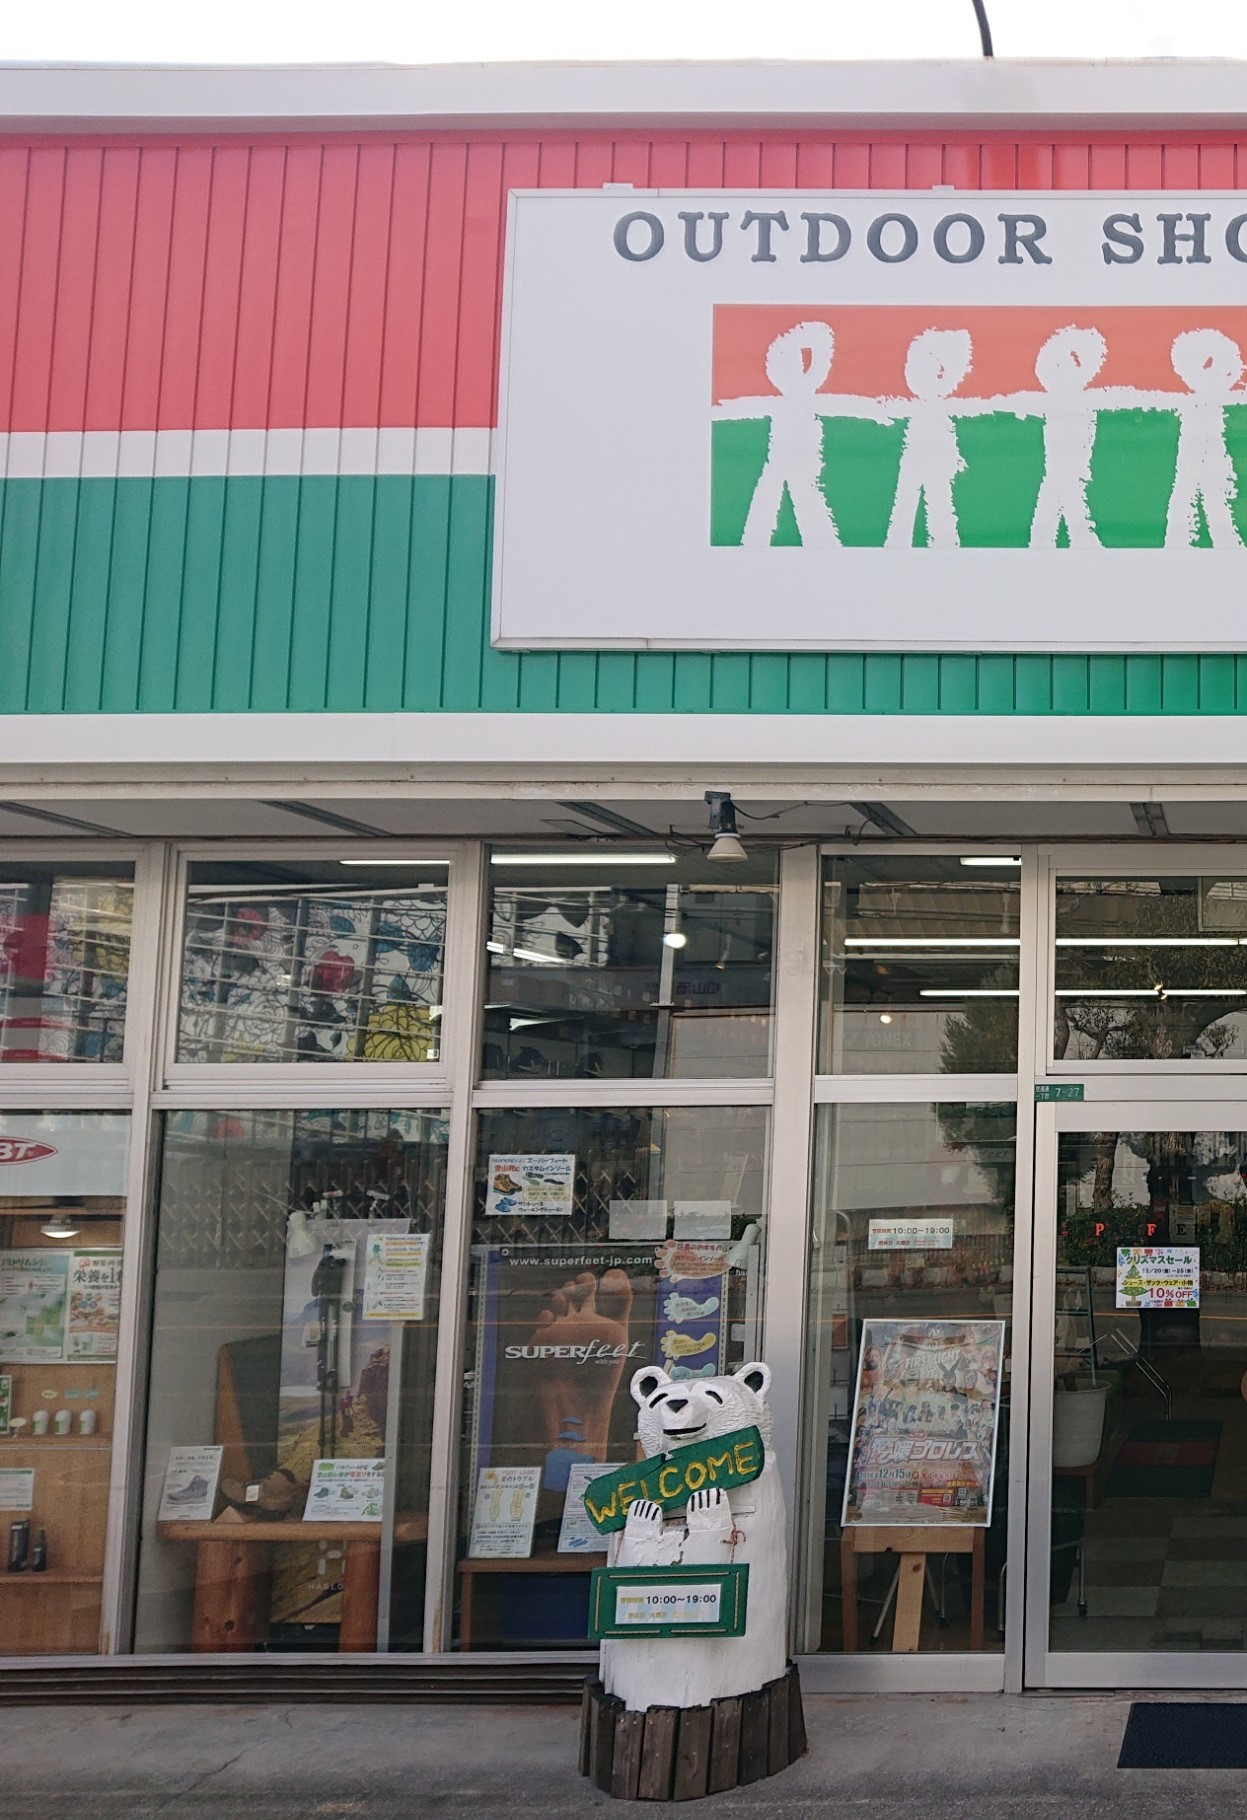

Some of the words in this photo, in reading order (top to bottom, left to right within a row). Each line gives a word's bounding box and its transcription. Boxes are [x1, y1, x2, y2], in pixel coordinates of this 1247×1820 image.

[613, 210, 1053, 265] OUTDOOR
[1055, 1087, 1080, 1098] 7-27
[509, 1255, 653, 1267] www.superfeet-jp.com
[1126, 1254, 1192, 1265] クリスマスセール
[585, 1441, 758, 1524] WELCOME
